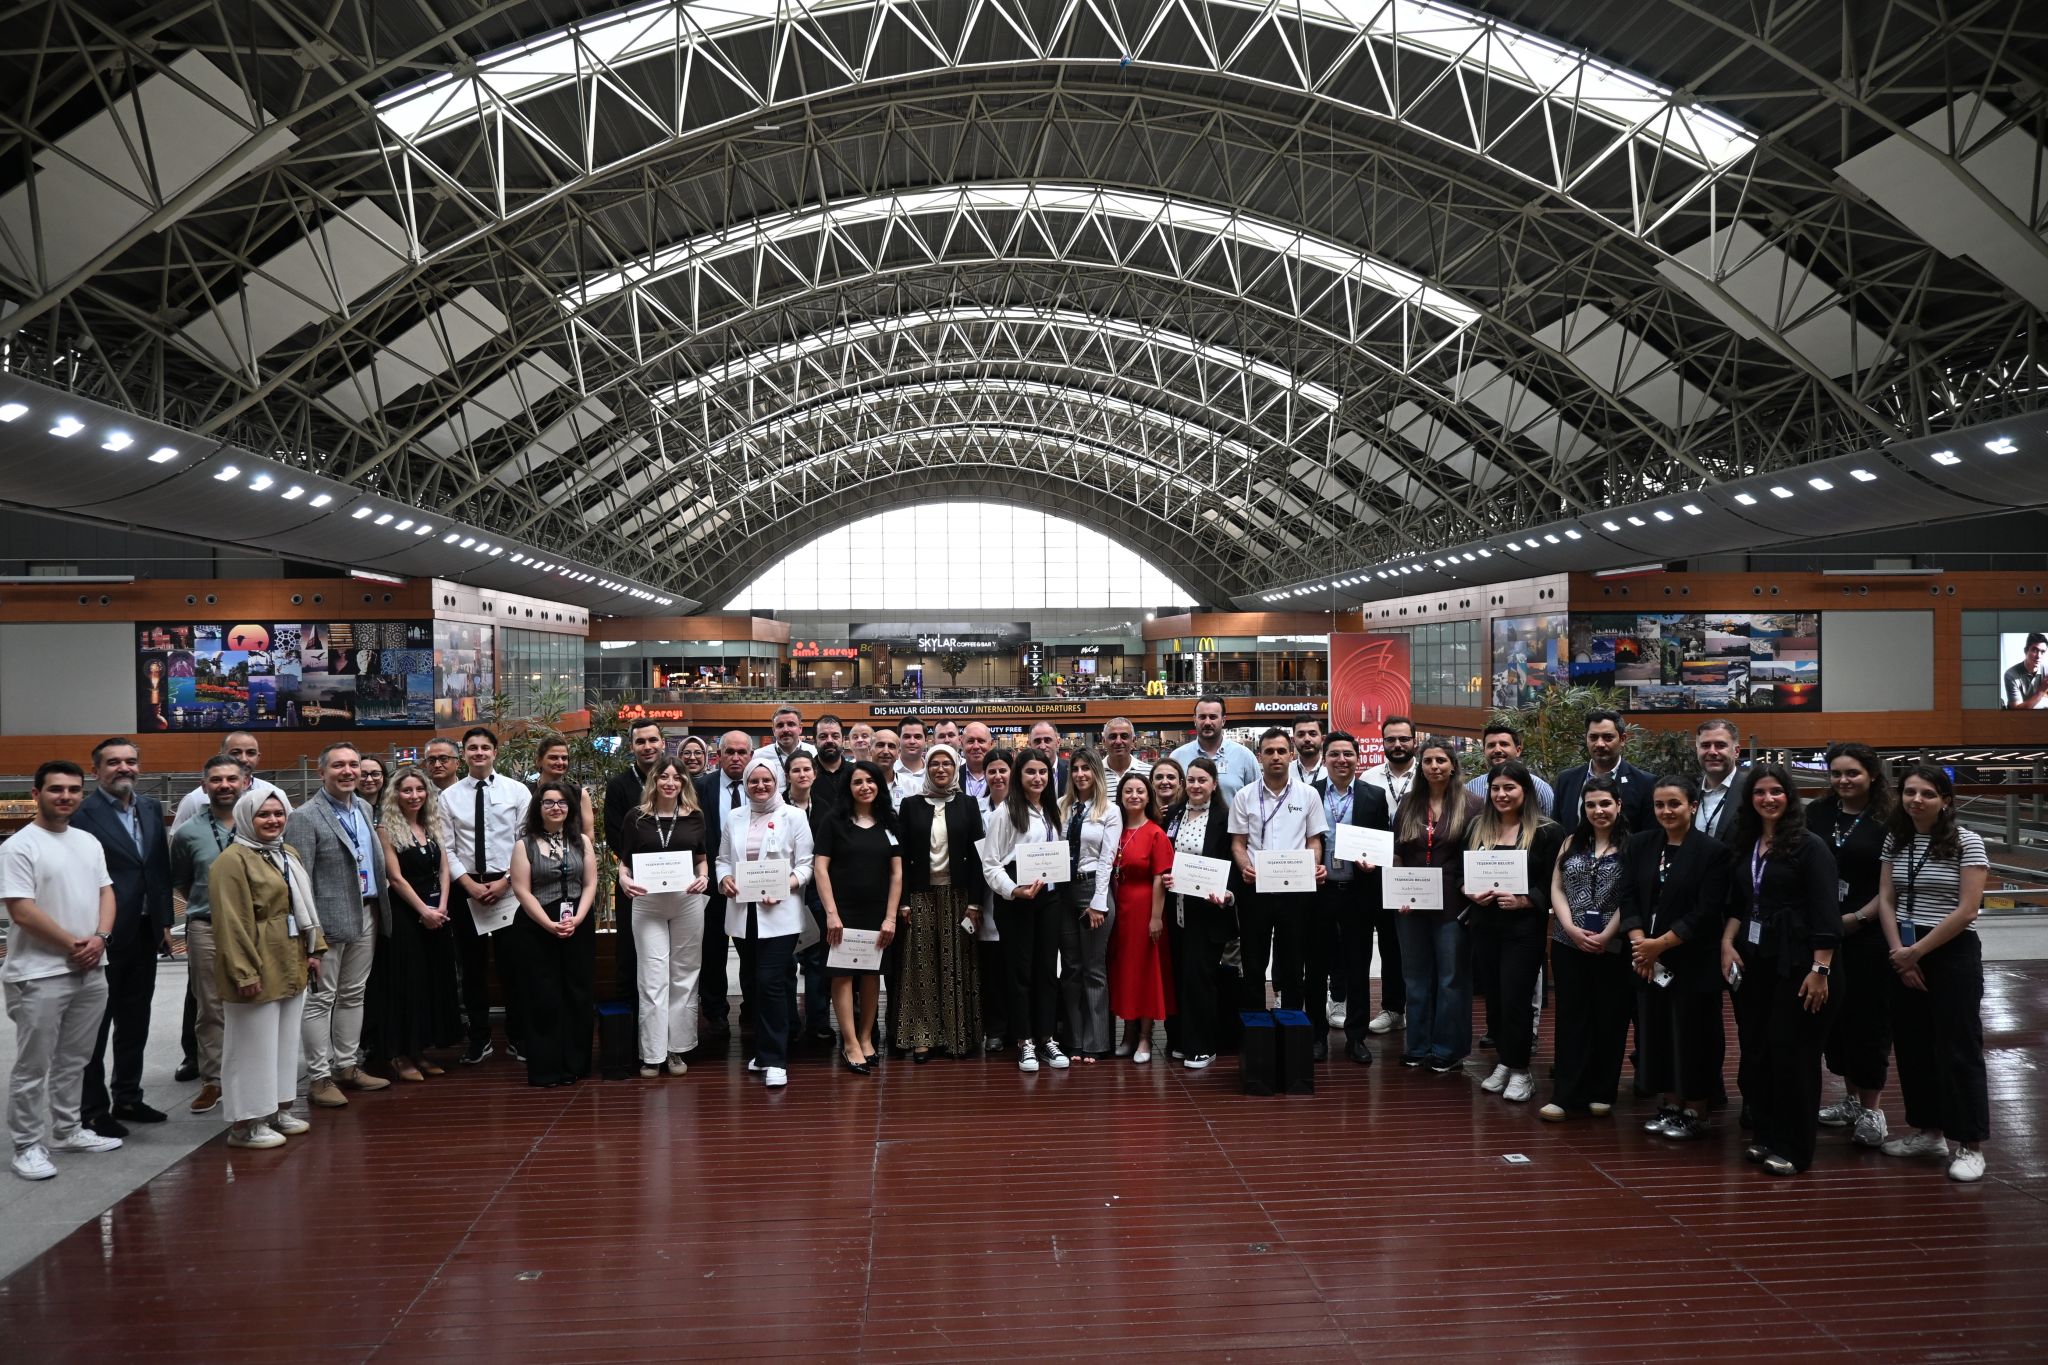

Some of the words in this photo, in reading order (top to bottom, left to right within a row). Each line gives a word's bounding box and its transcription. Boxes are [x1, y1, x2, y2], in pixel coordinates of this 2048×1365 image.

[918, 634, 956, 652] SKYLAR
[792, 641, 820, 656] simit
[874, 707, 887, 715] DIŞ
[889, 706, 917, 714] HATLAR
[919, 704, 943, 714] GİDEN
[976, 705, 1034, 713] INTERNATIONAL
[1036, 704, 1081, 713] DEPARTURES
[1254, 702, 1318, 712] McDonald's
[1359, 744, 1384, 753] UPA
[1369, 753, 1382, 763] GÜN
